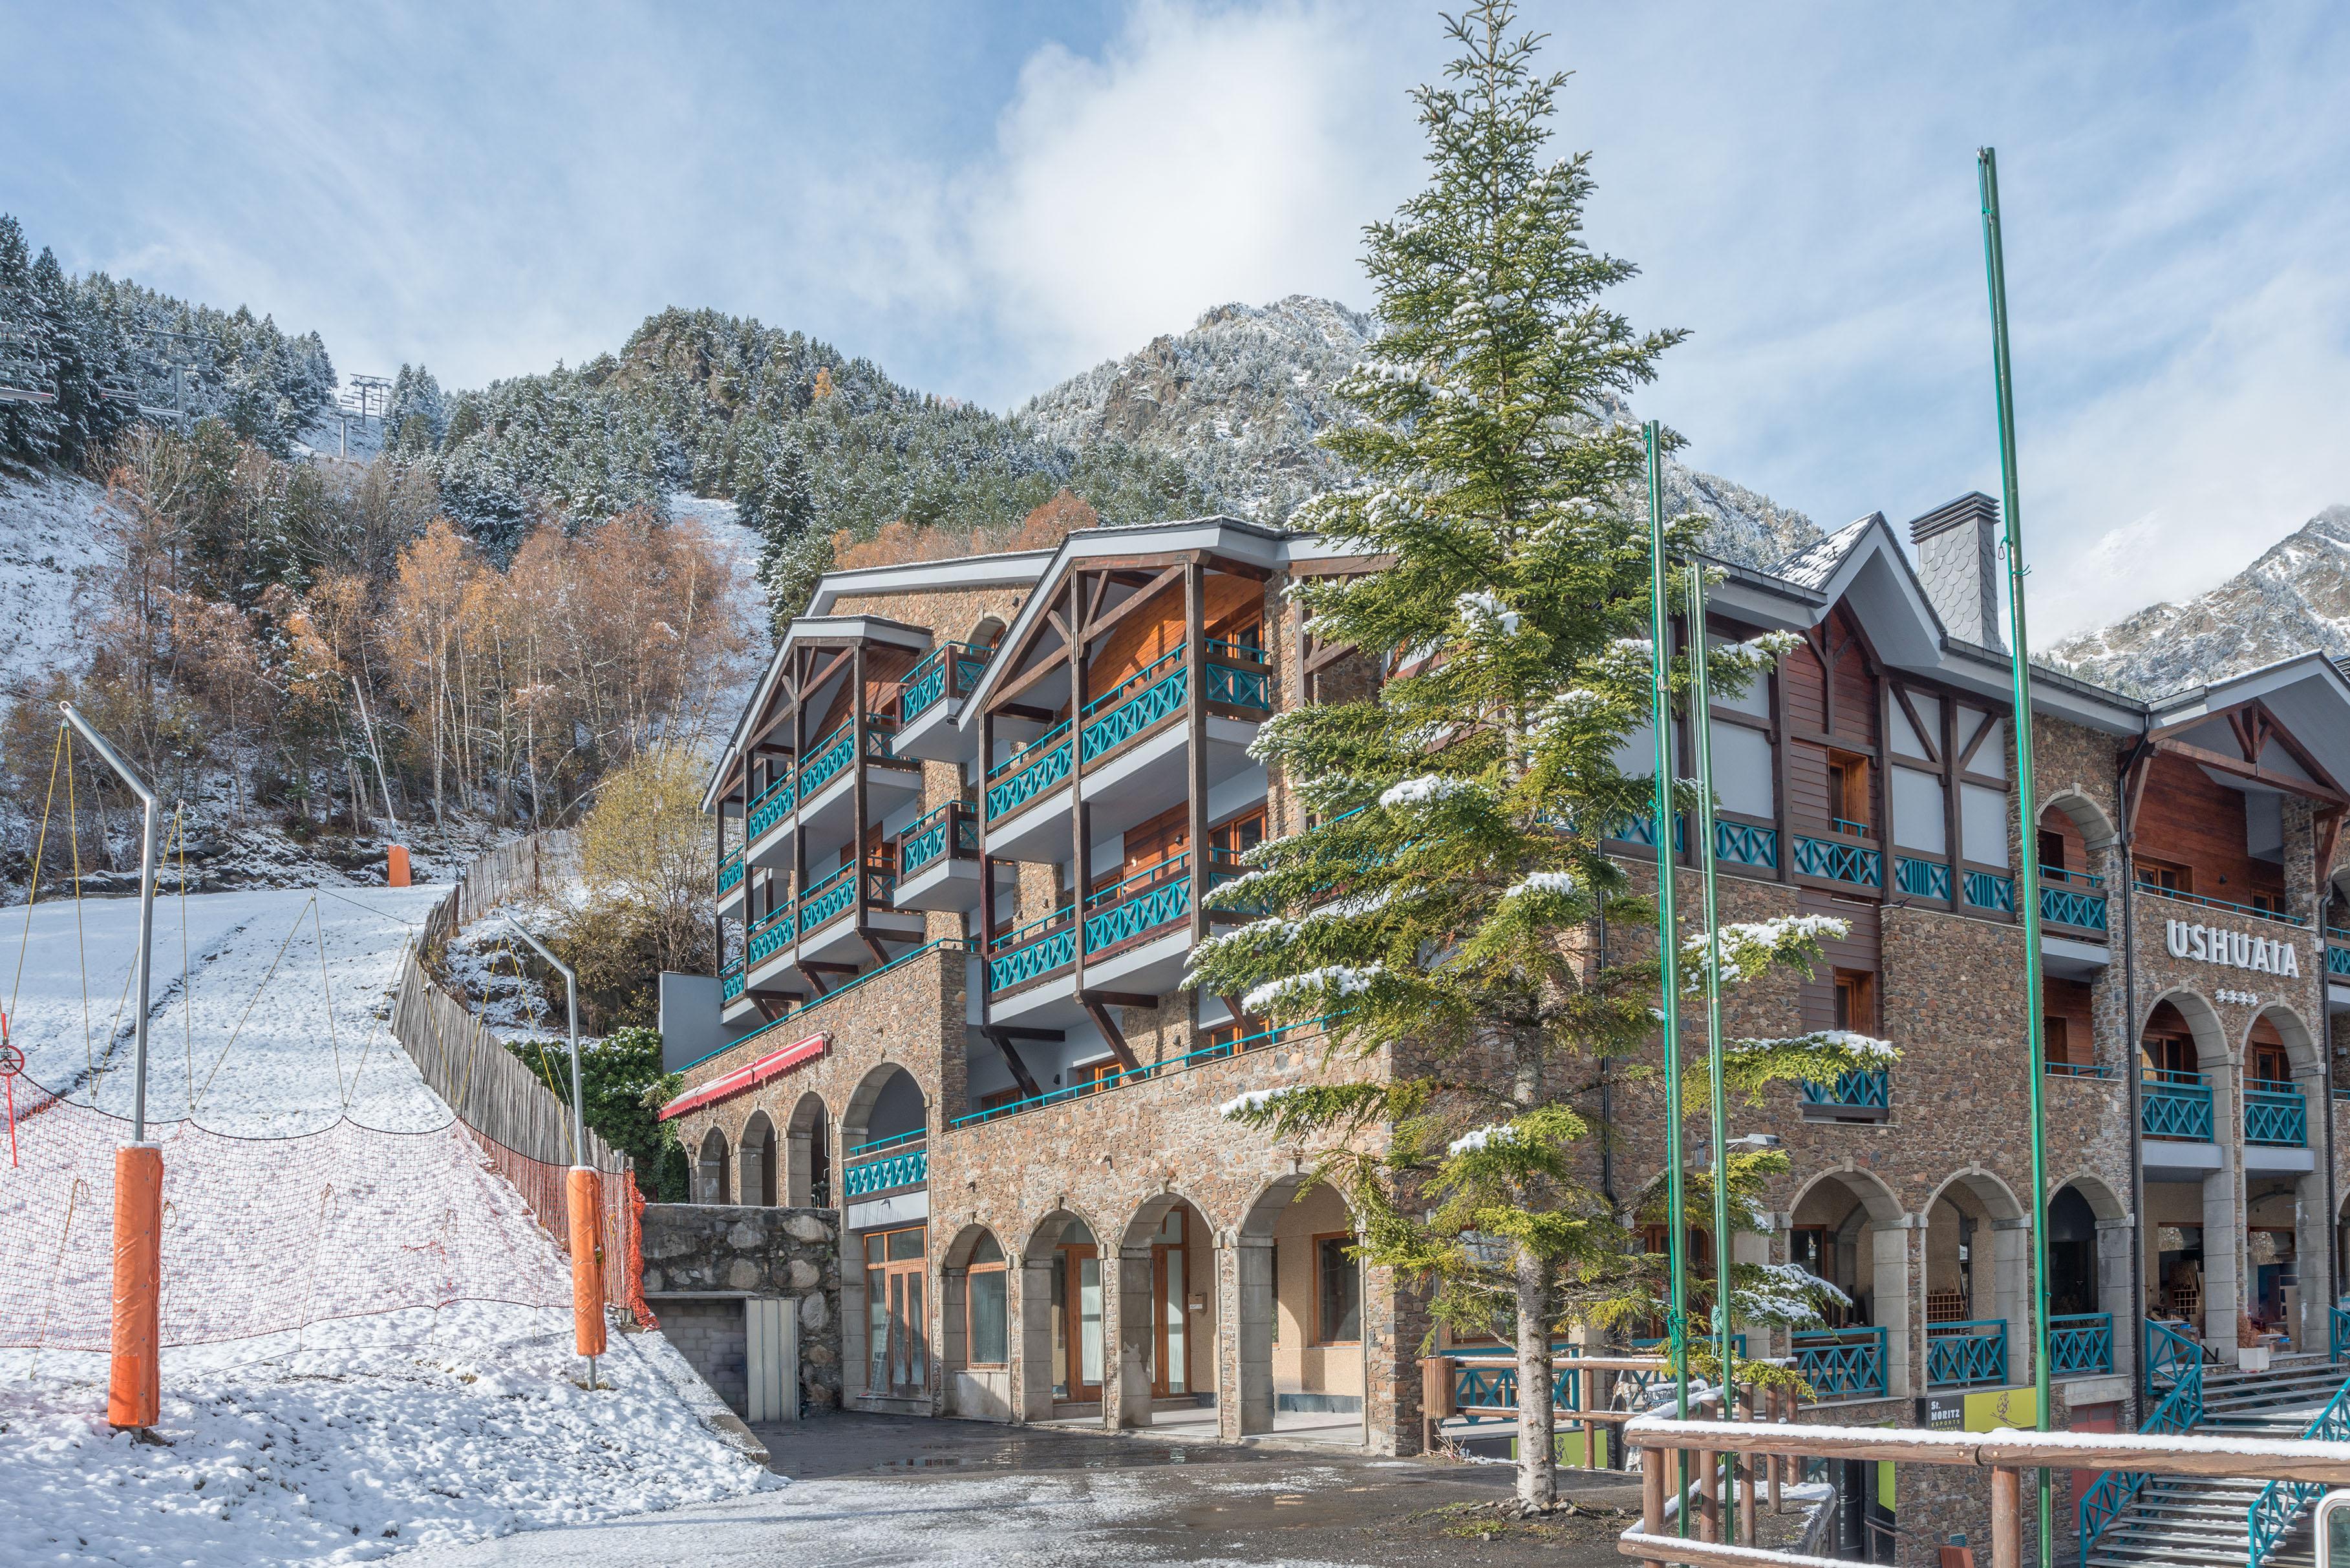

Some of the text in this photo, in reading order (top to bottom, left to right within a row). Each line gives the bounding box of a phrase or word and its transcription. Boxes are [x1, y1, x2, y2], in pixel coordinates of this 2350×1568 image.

[1931, 1401, 1941, 1410] St.
[1931, 1409, 1960, 1421] MORITZ
[1931, 1419, 1960, 1427] ESPORTS
